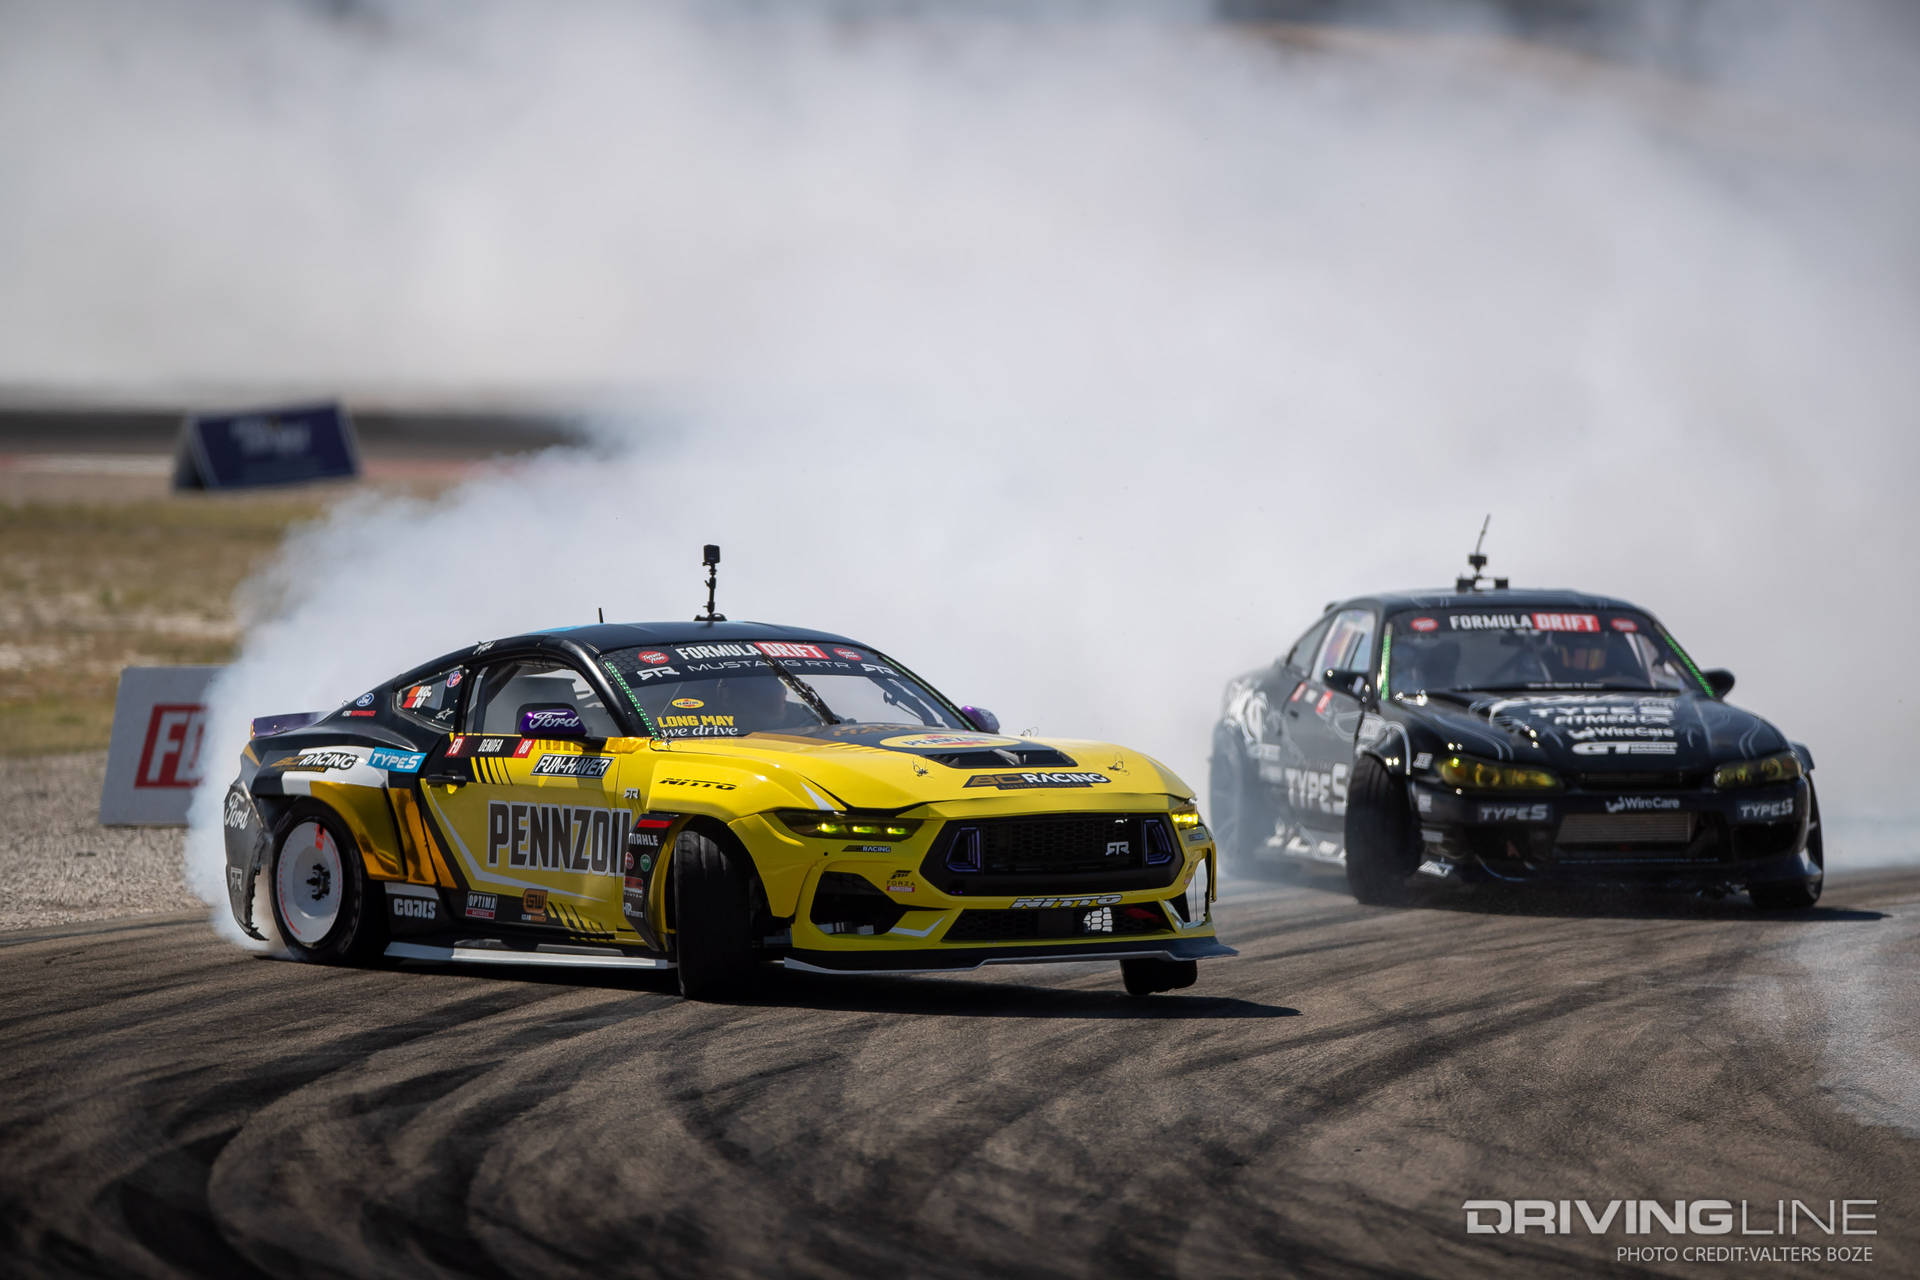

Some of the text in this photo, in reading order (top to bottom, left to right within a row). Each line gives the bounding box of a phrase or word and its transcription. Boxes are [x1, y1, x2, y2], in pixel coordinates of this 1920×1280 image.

[1450, 614, 1533, 631] FORMULA
[1536, 613, 1595, 632] DRIFT
[675, 644, 761, 661] FORMULA
[761, 643, 818, 659] DRIFT
[688, 659, 850, 672] MUSTAG RTR
[529, 711, 580, 730] Ford
[657, 715, 735, 728] LONG MAY
[661, 725, 739, 737] we drive
[1596, 726, 1675, 739] WireCare
[299, 751, 356, 770] RACING
[535, 754, 607, 776] FUN-HAVER
[658, 778, 738, 794] NITTO
[1021, 772, 1109, 785] RACING
[224, 791, 252, 830] Ford
[1624, 797, 1681, 809] WireCare
[628, 832, 659, 846] MAHLE
[468, 894, 496, 910] OPTIMA
[1010, 894, 1122, 909] NITTO
